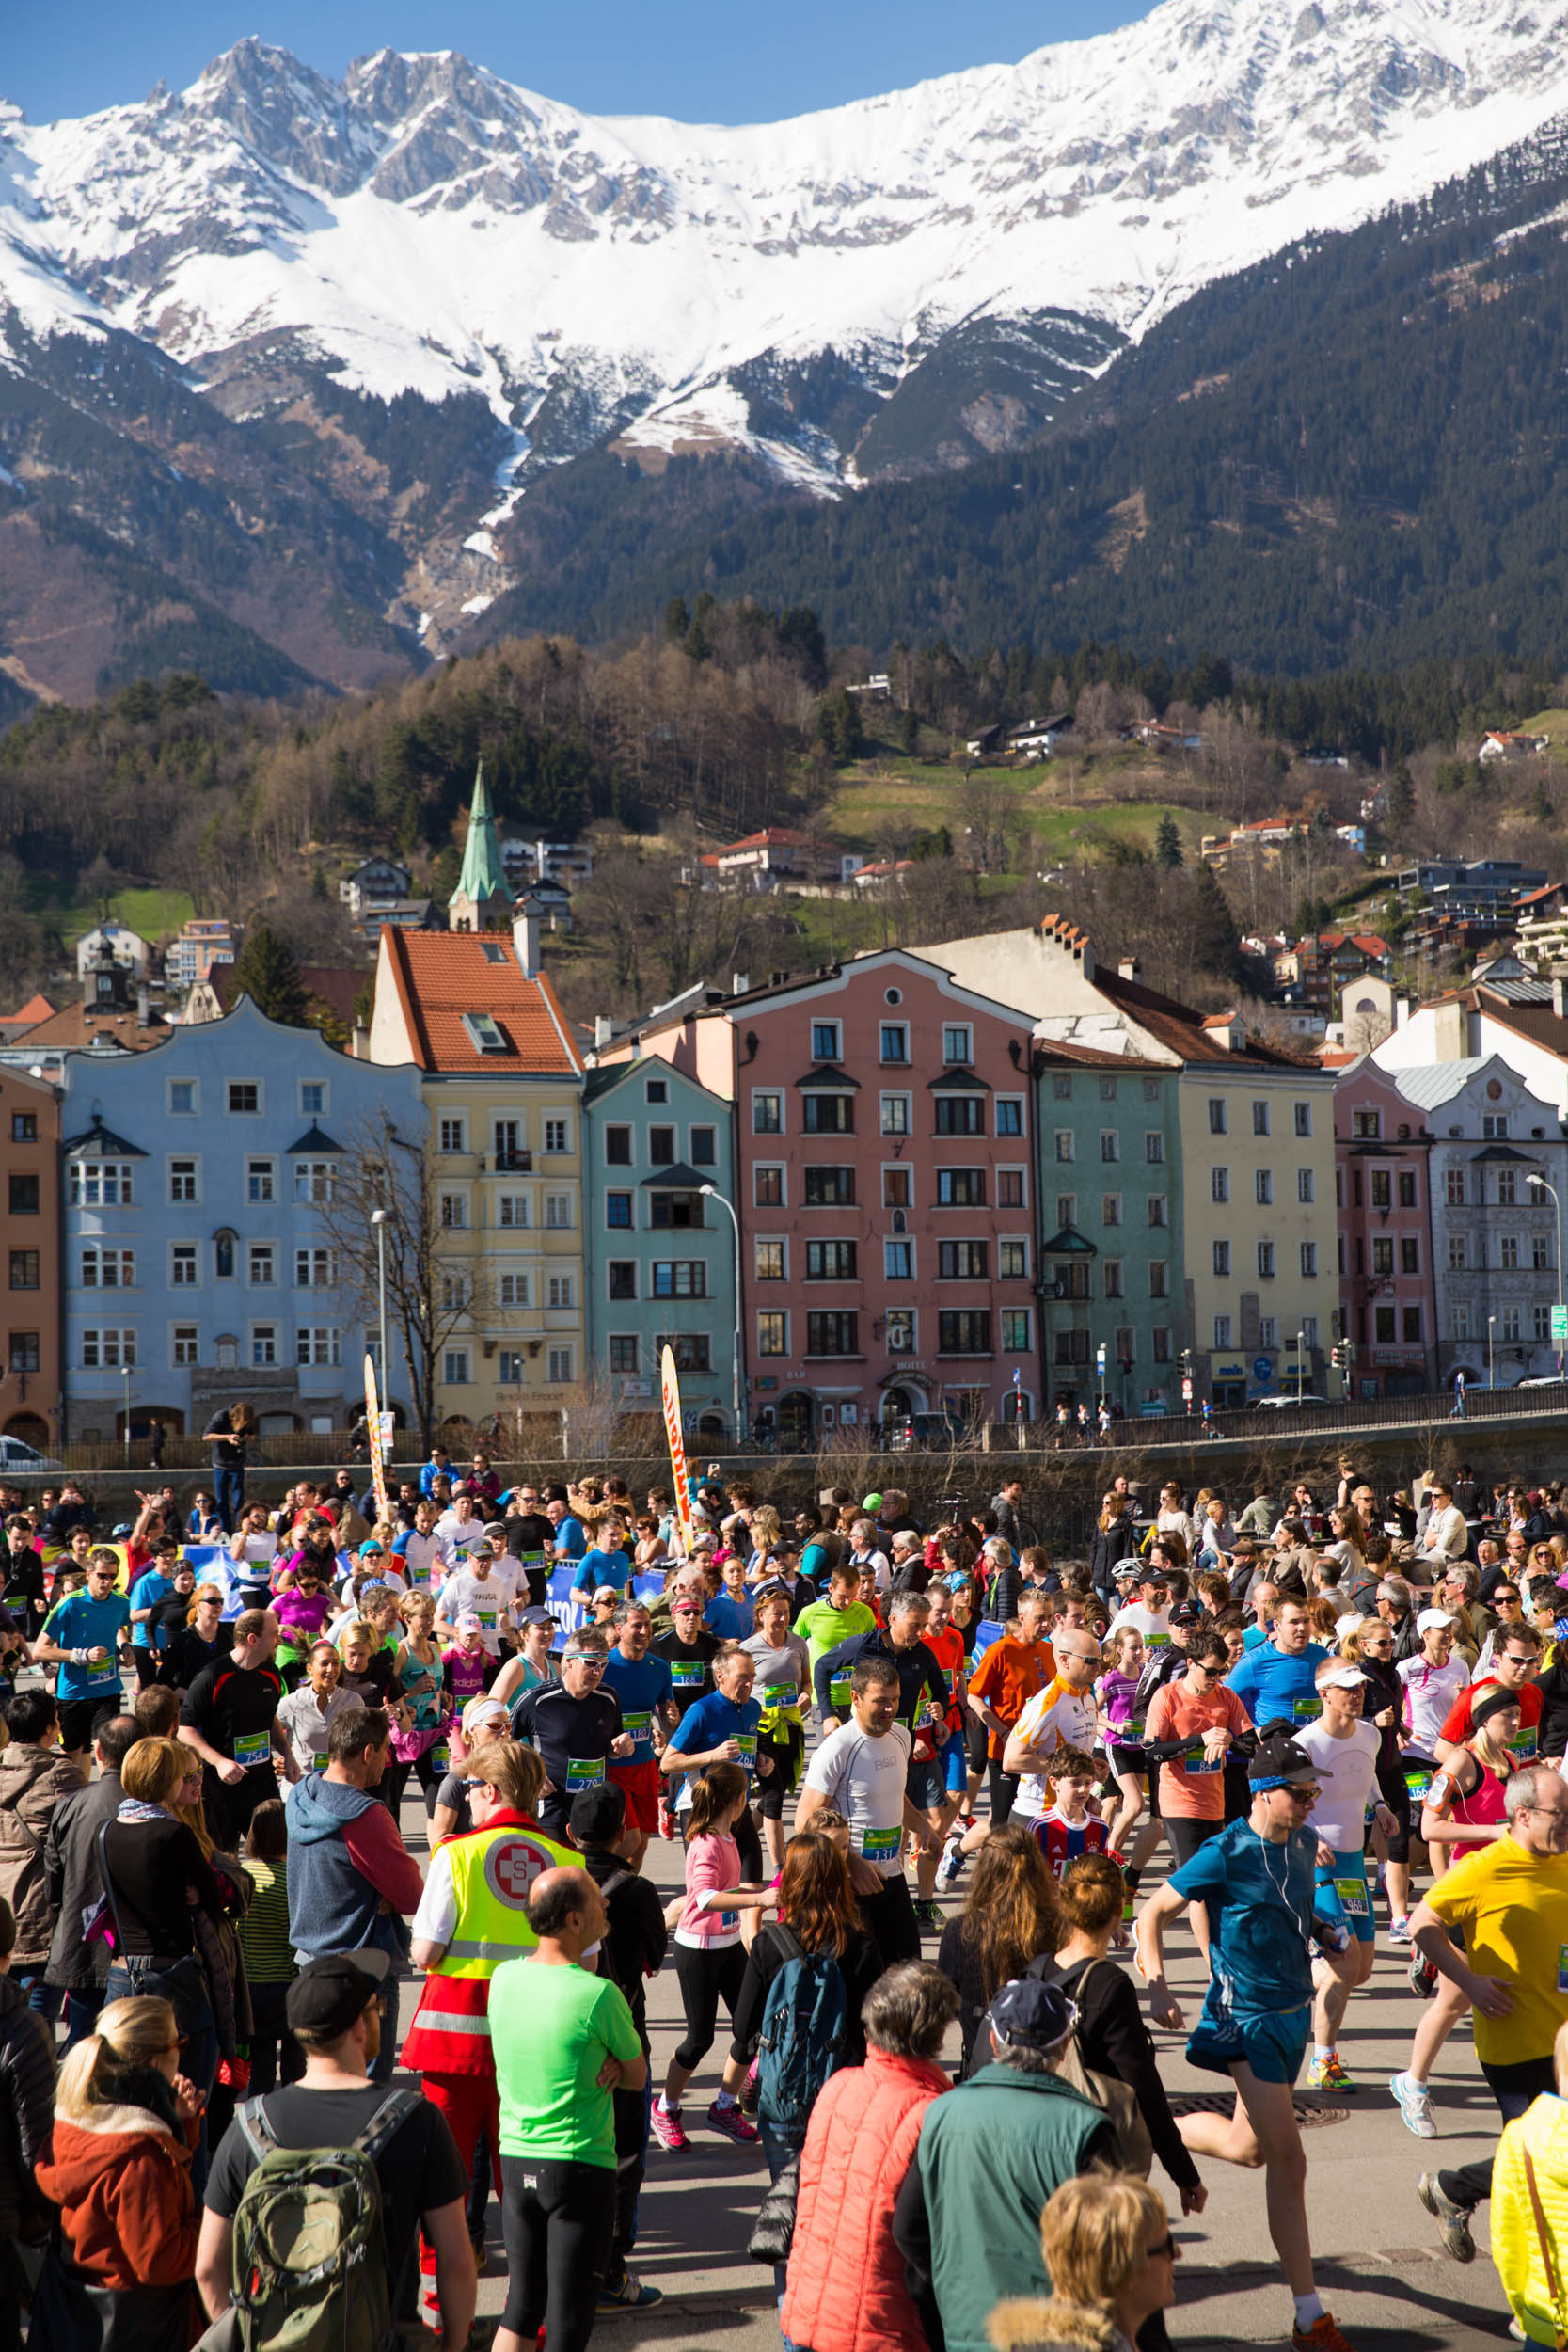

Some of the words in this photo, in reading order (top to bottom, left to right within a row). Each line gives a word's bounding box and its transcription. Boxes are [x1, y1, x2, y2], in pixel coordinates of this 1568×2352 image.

[897, 1361, 927, 1370] HOTEL
[786, 1371, 805, 1379] BAR
[680, 1676, 696, 1684] 188
[776, 1697, 787, 1707] 82
[246, 1750, 263, 1762] 754
[1199, 1760, 1212, 1772] 84
[1411, 1787, 1427, 1798] 166
[875, 1849, 893, 1861] 131
[513, 1860, 527, 1880] S
